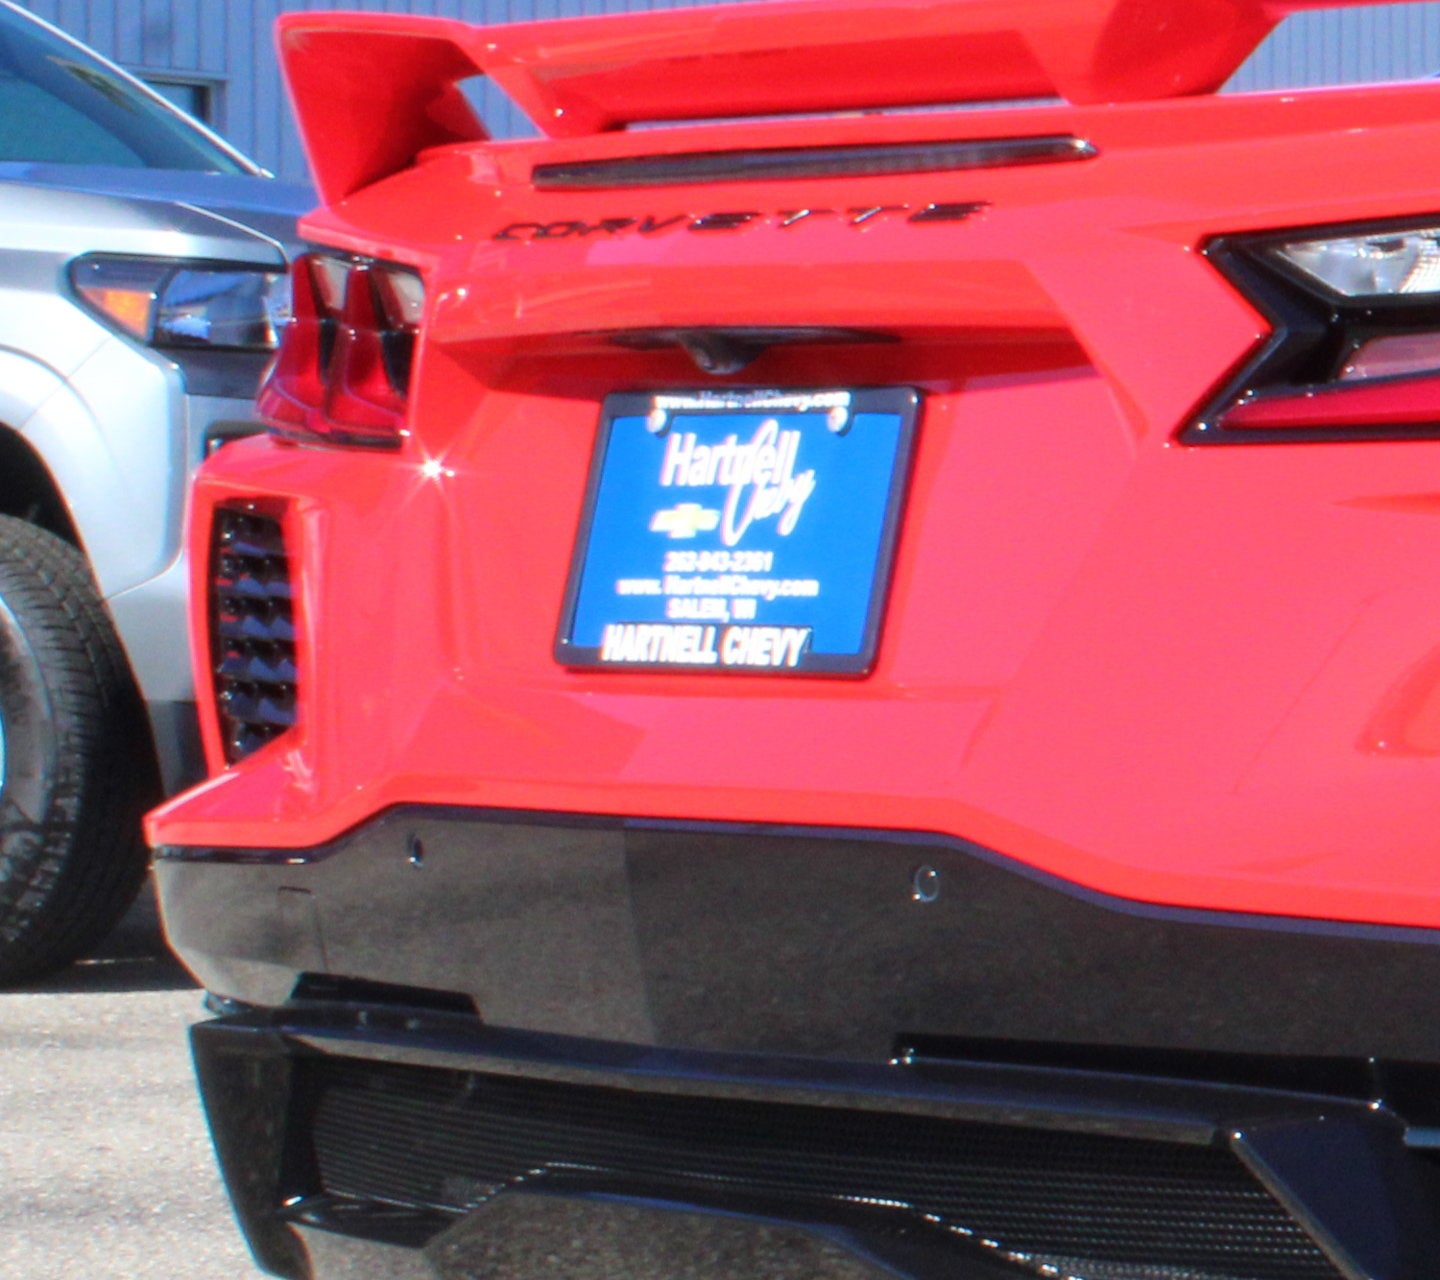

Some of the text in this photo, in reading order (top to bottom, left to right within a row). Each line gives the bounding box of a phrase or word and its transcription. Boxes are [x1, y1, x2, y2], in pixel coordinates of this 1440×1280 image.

[493, 202, 991, 241] CORVETTE
[661, 432, 801, 486] Hartnell
[601, 623, 809, 667] HARTNELL CHEVY
